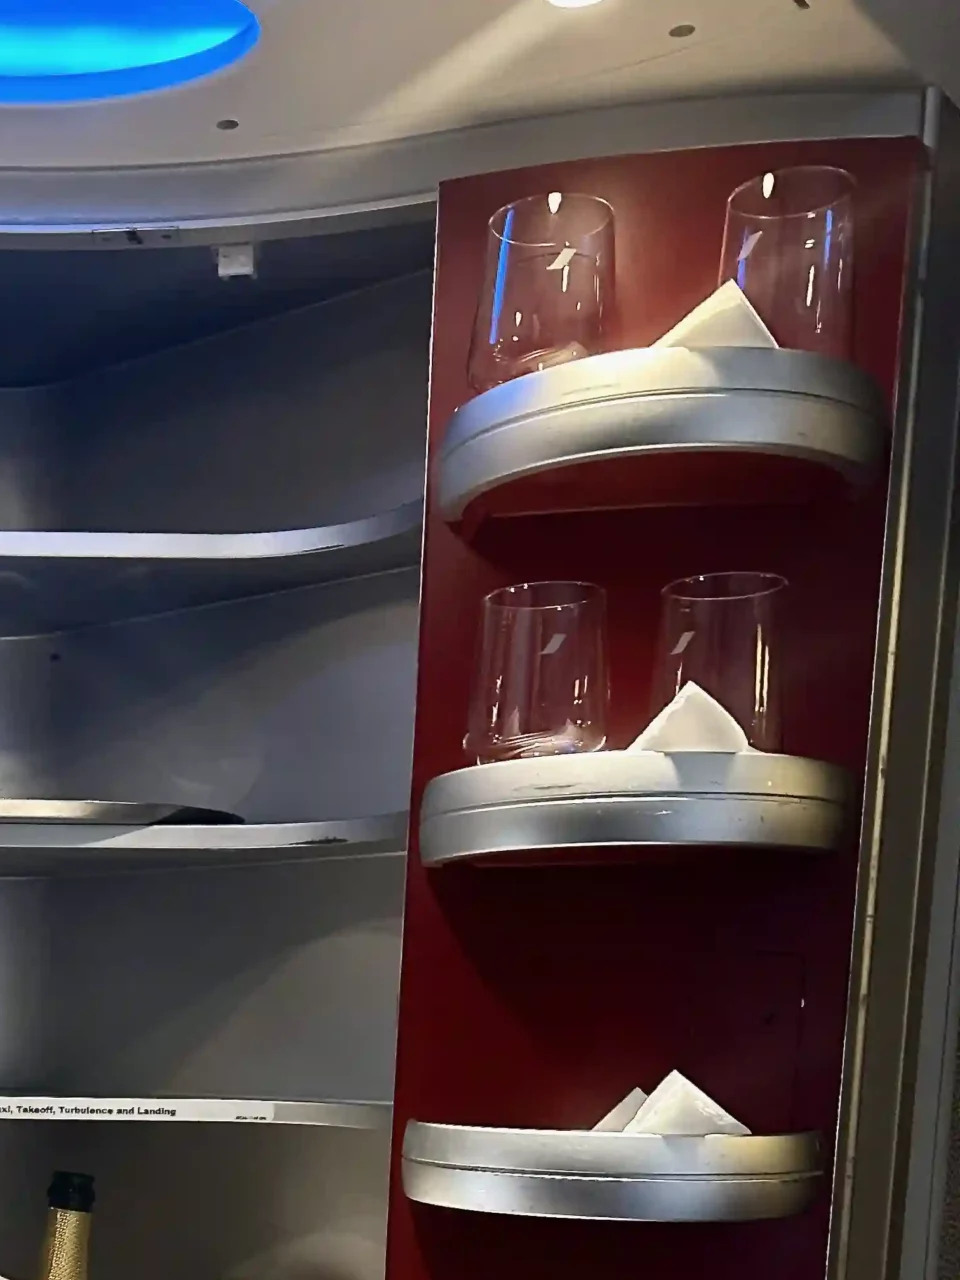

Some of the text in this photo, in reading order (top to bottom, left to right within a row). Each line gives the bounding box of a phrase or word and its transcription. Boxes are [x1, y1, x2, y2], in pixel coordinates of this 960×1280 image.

[16, 1105, 57, 1116] Takeoff,
[59, 1106, 114, 1115] Turbulence
[116, 1107, 135, 1115] and
[137, 1107, 177, 1117] Landing
